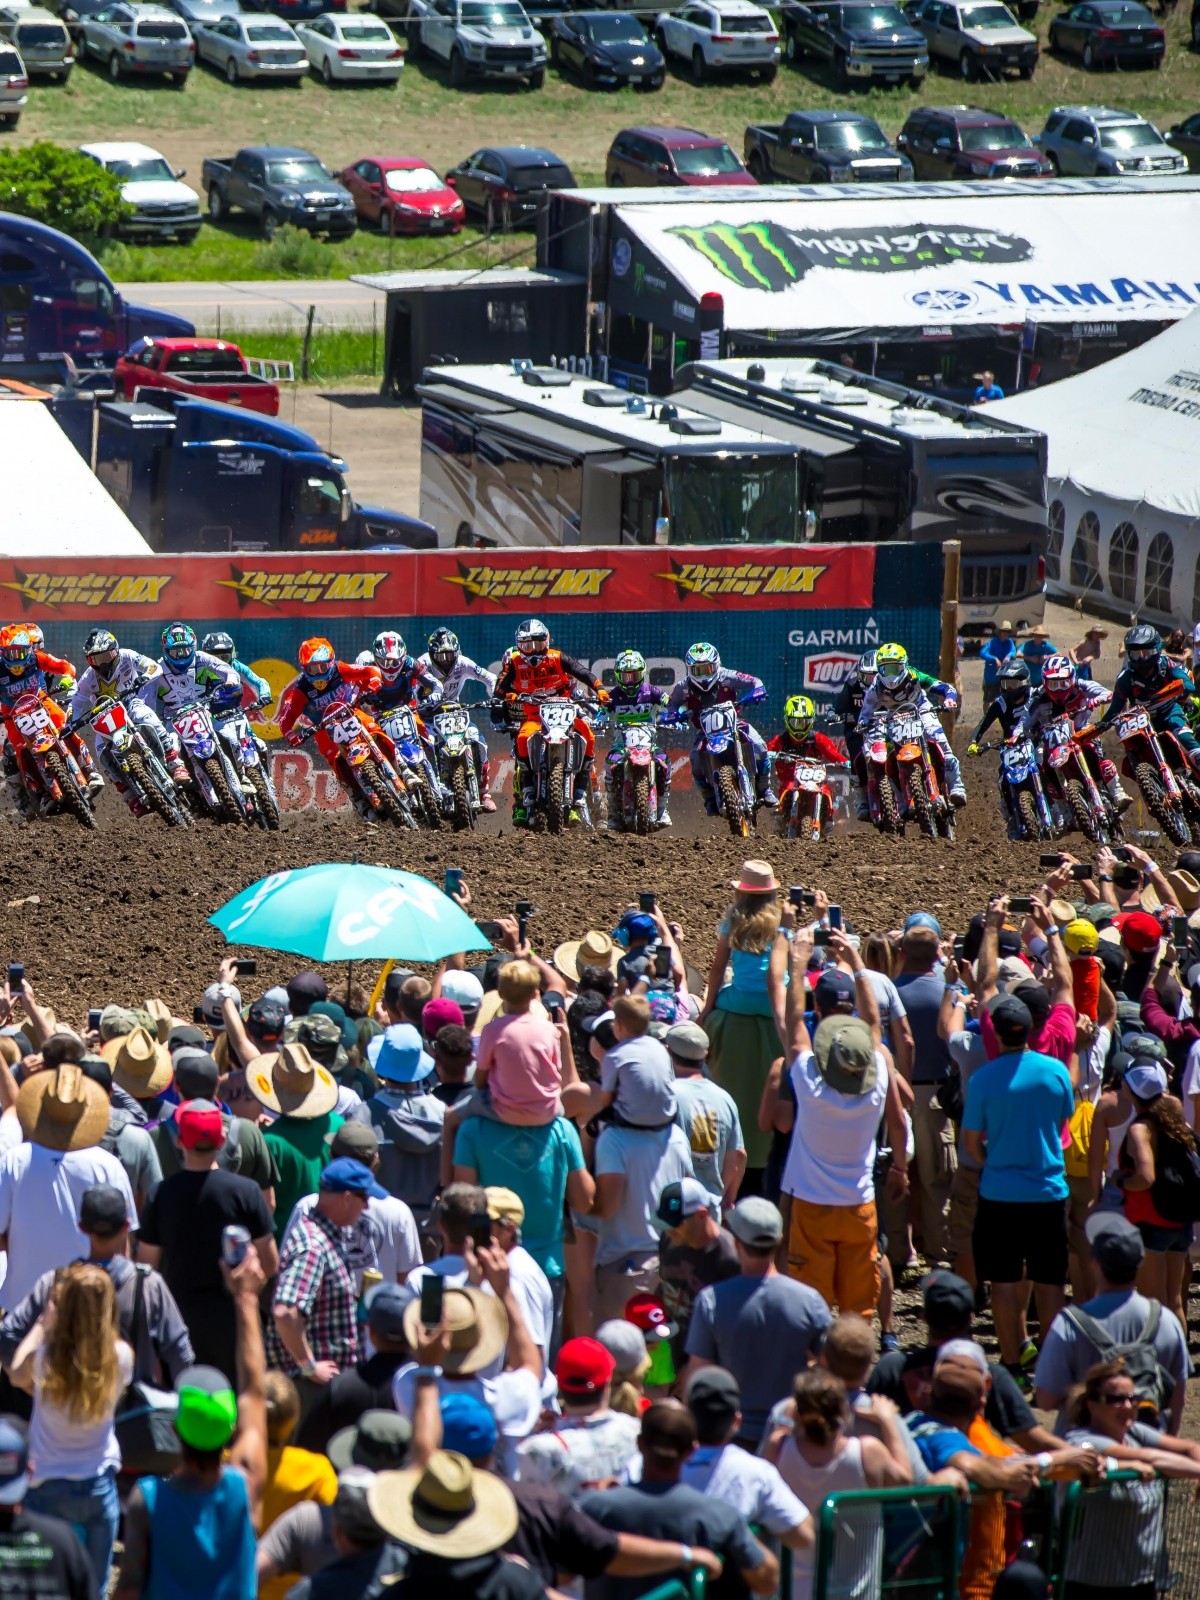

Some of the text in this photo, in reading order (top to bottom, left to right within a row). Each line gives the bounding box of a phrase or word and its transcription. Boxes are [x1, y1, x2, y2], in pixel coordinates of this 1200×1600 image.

[787, 230, 1014, 257] MONSTER
[972, 277, 1200, 306] YAMAH
[22, 572, 119, 589] Thunder
[241, 569, 335, 586] Thunder
[467, 566, 564, 584] Thunder
[479, 568, 614, 599] Valley MX
[680, 564, 777, 581] Thunder
[691, 565, 828, 596] Valley MX
[34, 575, 173, 606] Valley MX
[253, 572, 388, 603] Valley MX
[788, 629, 879, 646] GARMIN
[16, 708, 50, 737] 28
[101, 715, 117, 733] 1
[439, 716, 467, 735] 133
[542, 707, 573, 727] 130
[1120, 713, 1149, 738] 458
[333, 716, 362, 746] 43
[625, 727, 651, 747] 82
[892, 719, 925, 743] 346
